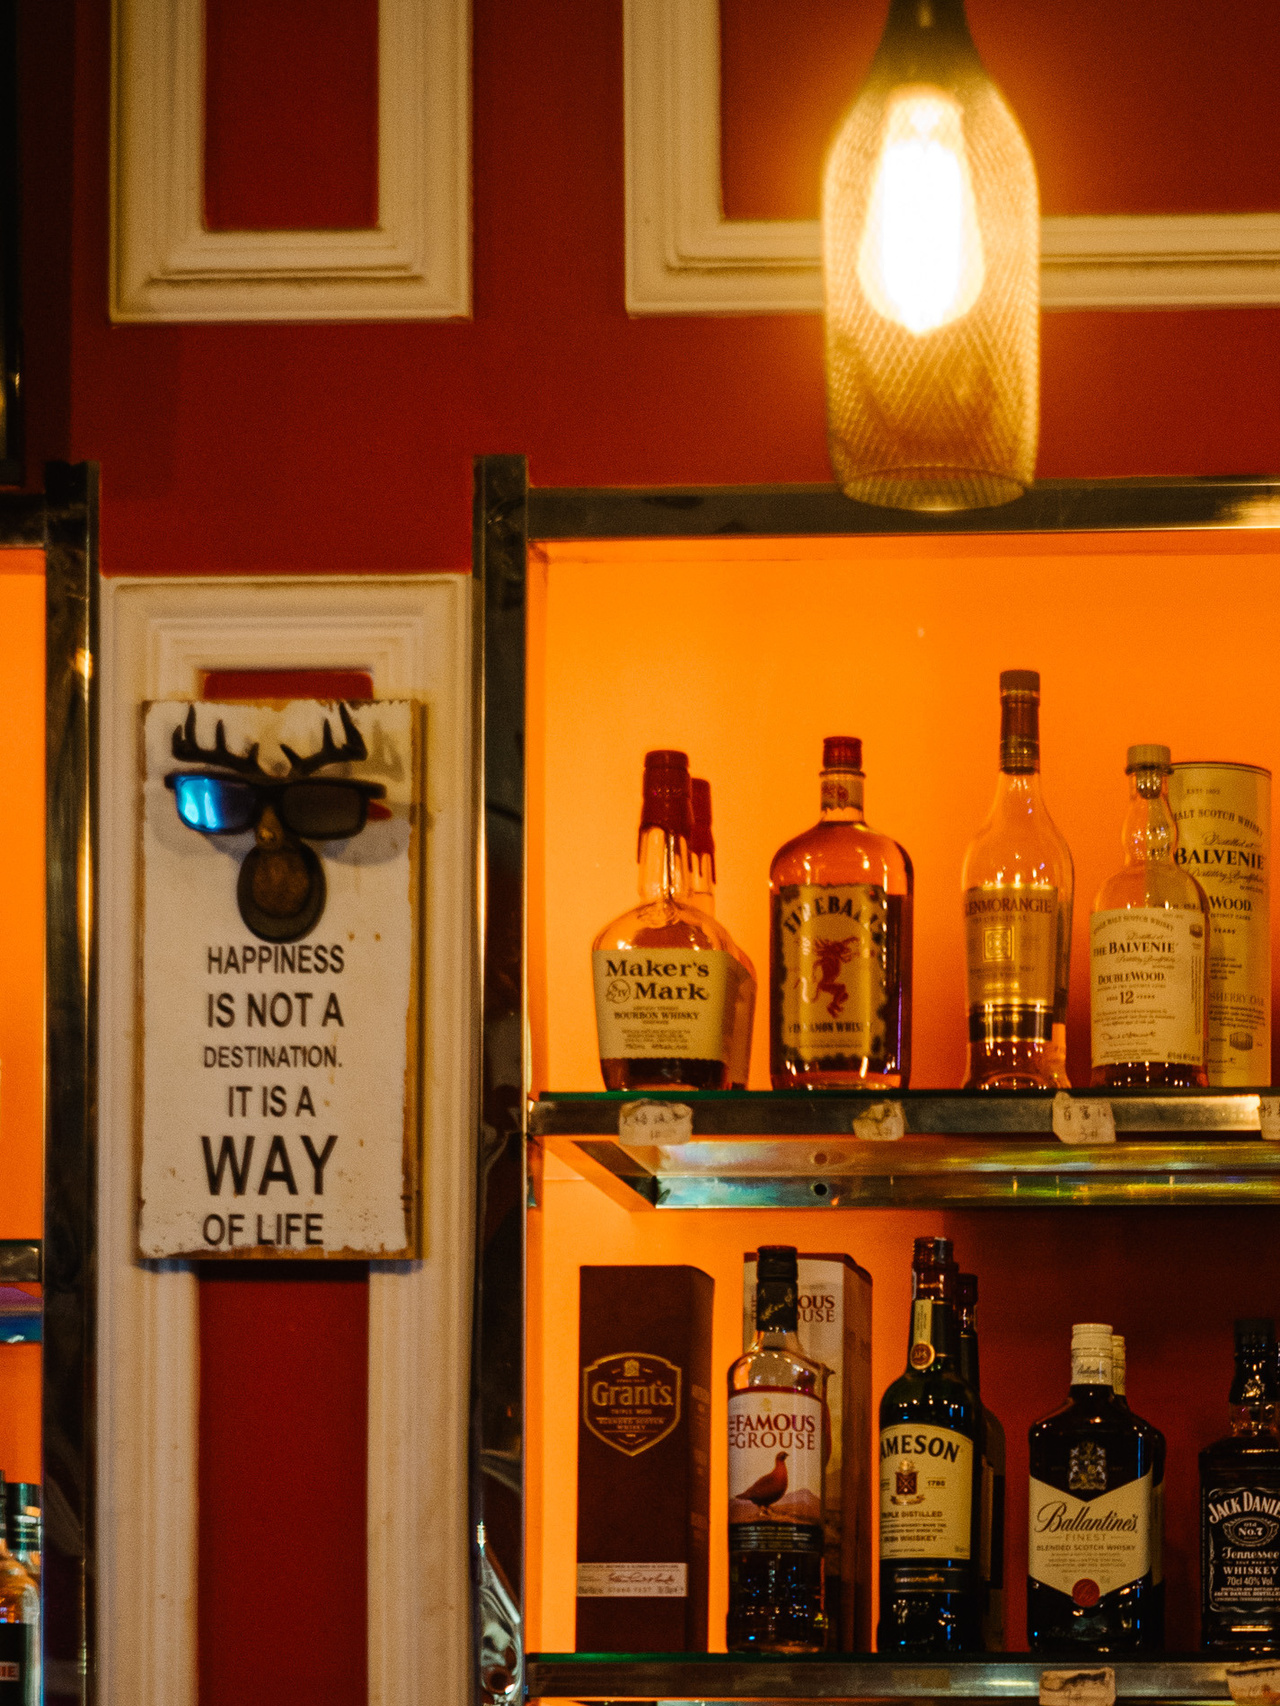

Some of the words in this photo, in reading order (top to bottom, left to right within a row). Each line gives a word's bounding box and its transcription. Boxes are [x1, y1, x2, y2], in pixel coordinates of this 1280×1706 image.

[1198, 809, 1235, 822] SCOTCH
[1174, 848, 1264, 870] BALVENIE
[207, 945, 344, 974] HAPPINESS
[1109, 942, 1175, 955] BALVENIE
[606, 960, 709, 977] Maker's
[634, 982, 708, 1001] Mark
[1119, 991, 1134, 1005] 12
[207, 993, 235, 1028] IS
[246, 993, 314, 1028] NOT
[321, 993, 344, 1027] A
[203, 1046, 342, 1069] DESTINATION.
[227, 1086, 252, 1117] IT
[262, 1086, 287, 1117] IS
[295, 1086, 316, 1117] A
[201, 1135, 338, 1196] WAY
[202, 1214, 246, 1246] OF
[256, 1214, 324, 1246] LIFE
[592, 1380, 674, 1406] Grant's
[736, 1413, 815, 1433] FAMOUS
[735, 1432, 815, 1450] GROUSE
[880, 1434, 961, 1463] AMESON
[1034, 1500, 1138, 1533] Ballantine's
[1208, 1496, 1242, 1524] JACK
[1222, 1546, 1280, 1559] Tennessee
[1223, 1566, 1279, 1575] WHISKEY
[1243, 1576, 1260, 1586] 40%
